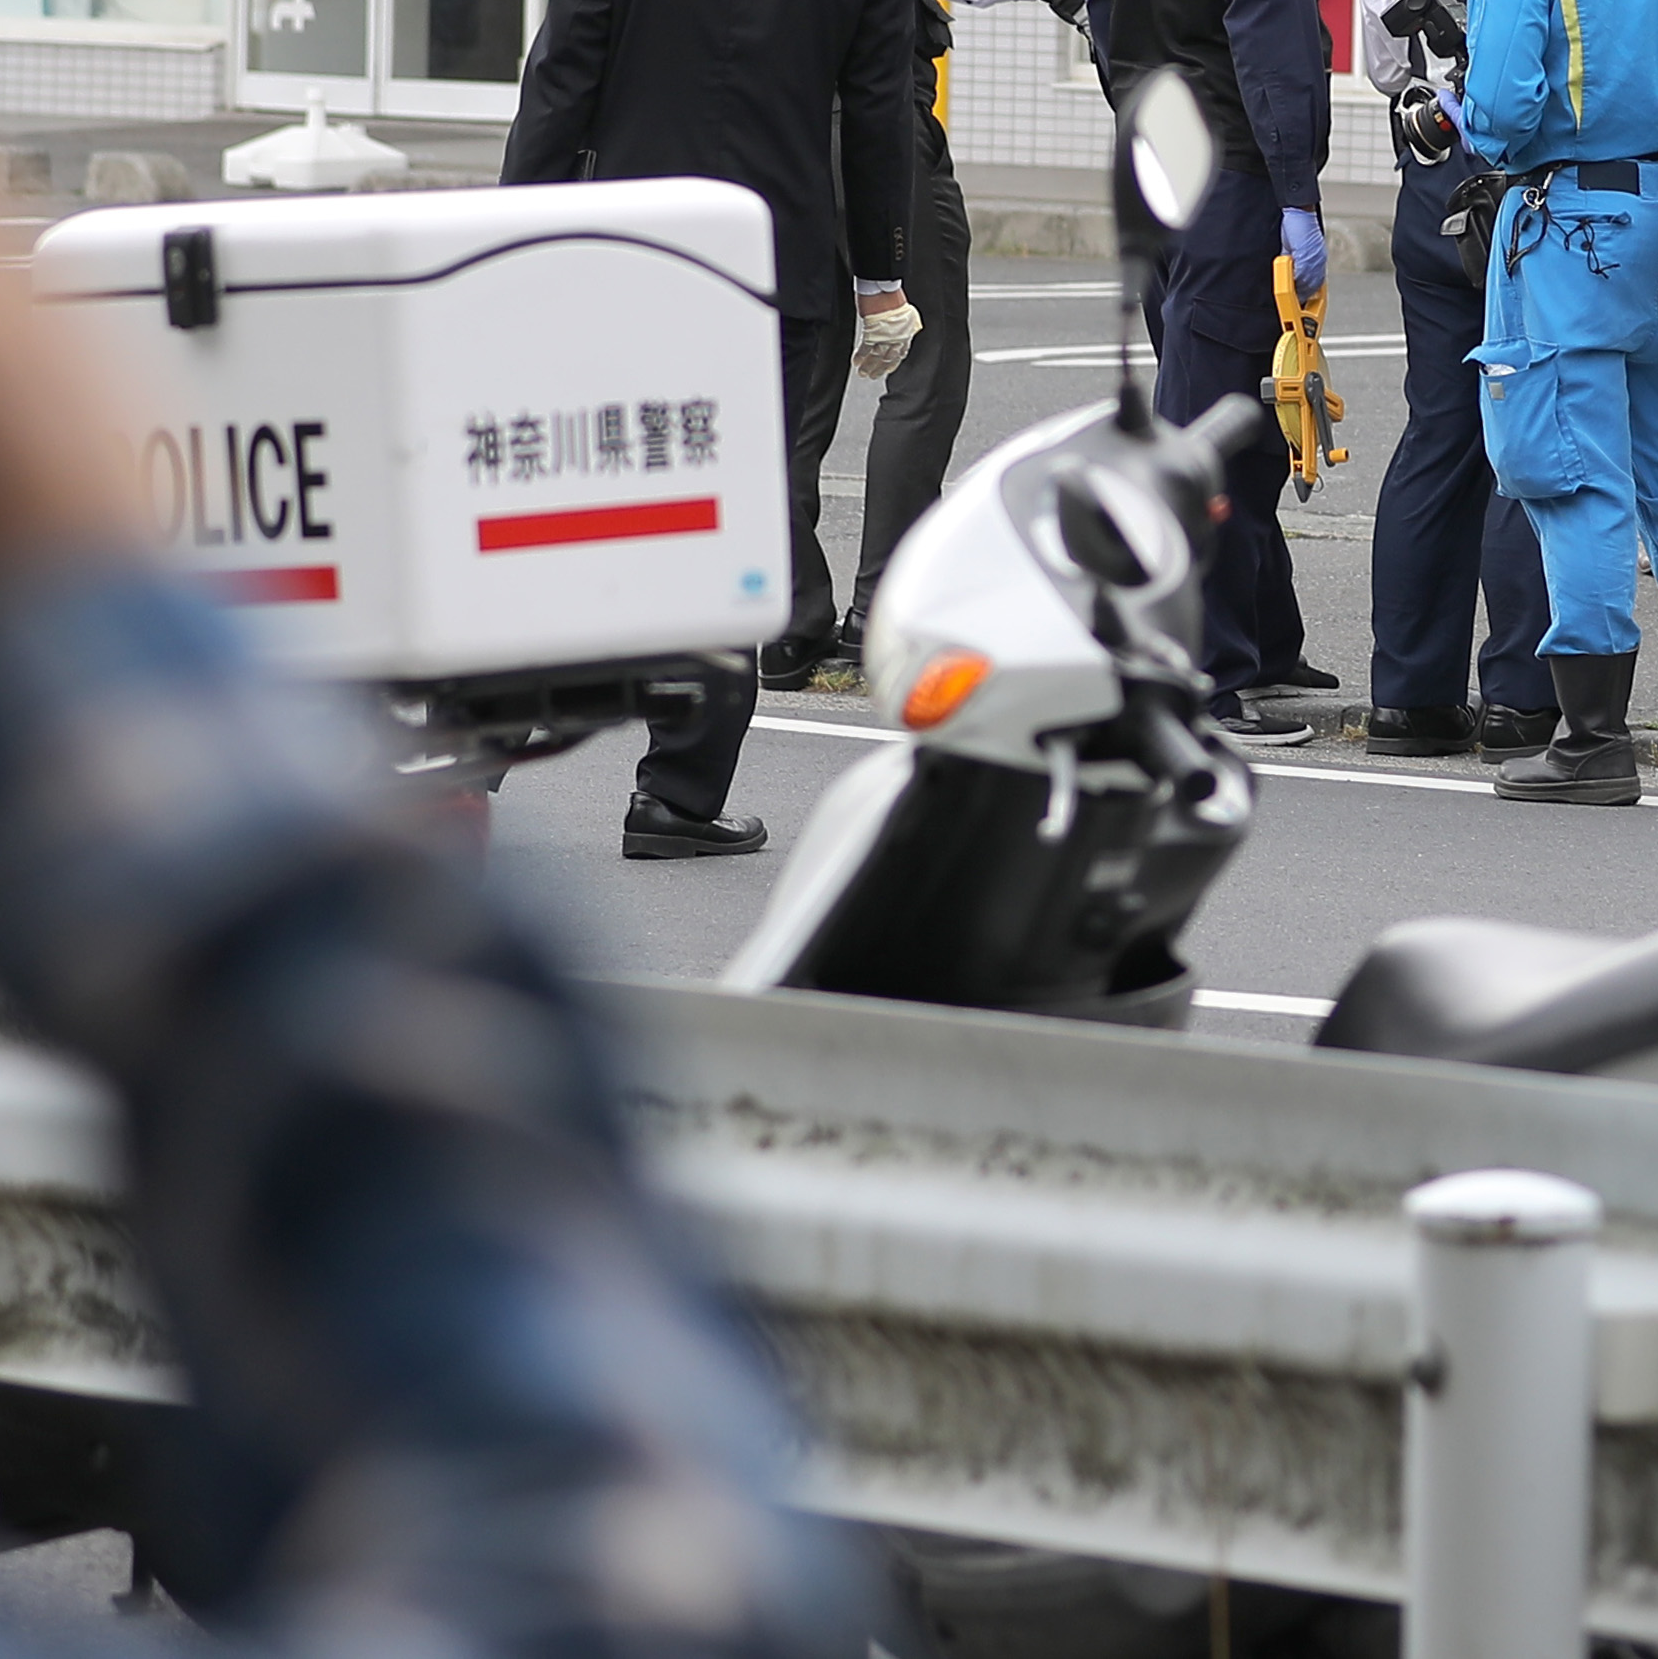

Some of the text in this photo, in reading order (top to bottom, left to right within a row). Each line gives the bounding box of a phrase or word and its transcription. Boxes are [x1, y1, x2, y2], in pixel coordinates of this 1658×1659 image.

[142, 420, 332, 545] OLICE
[465, 397, 721, 485] 神奈川県警察
